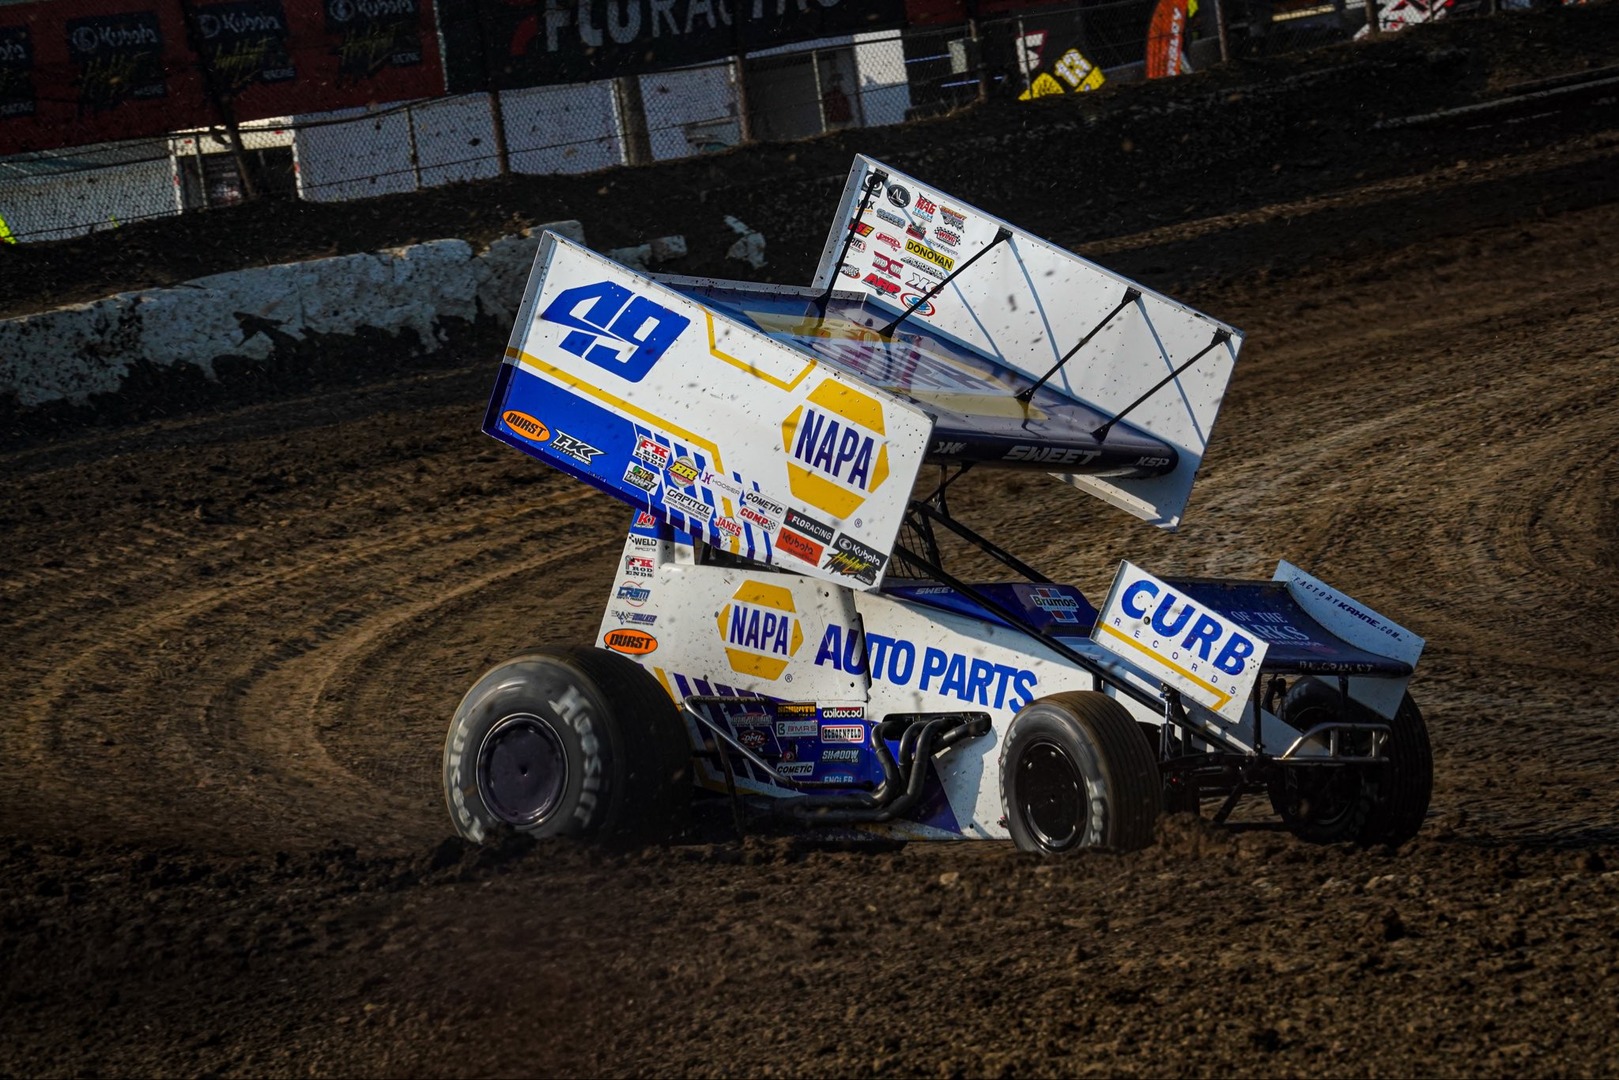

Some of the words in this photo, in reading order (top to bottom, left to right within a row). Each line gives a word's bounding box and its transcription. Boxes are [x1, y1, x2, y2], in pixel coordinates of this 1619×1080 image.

[907, 241, 953, 269] DONOVAN
[863, 273, 901, 294] ARP
[540, 280, 691, 384] 49
[506, 412, 546, 438] DURST
[640, 438, 669, 459] FK
[642, 449, 666, 464] ROD
[795, 408, 876, 490] NAPA
[1002, 445, 1102, 466] SWEET
[634, 451, 664, 469] ENDS
[1136, 456, 1170, 468] KSP
[626, 472, 657, 491] DRAFT
[712, 479, 740, 495] HOOSIER
[667, 488, 710, 515] CAPITOL
[746, 492, 783, 515] COMETIC
[715, 516, 742, 536] JAKES
[791, 514, 832, 540] FLORACING
[634, 537, 657, 547] WELD
[782, 531, 814, 556] Kubota
[852, 543, 881, 567] Kubota
[1033, 595, 1077, 609] Brumos
[1121, 579, 1254, 676] CURB
[1231, 610, 1251, 622] OF
[1254, 611, 1289, 624] THE
[730, 604, 789, 656] NAPA
[609, 632, 653, 650] DURST
[1113, 617, 1236, 695] RECORDS
[815, 623, 917, 685] AUTO
[919, 646, 1038, 715] PARTS
[822, 708, 863, 719] wilwood
[823, 727, 862, 739] SCHOENFELD
[822, 749, 860, 760] SHADOW
[777, 764, 813, 774] COMETIC
